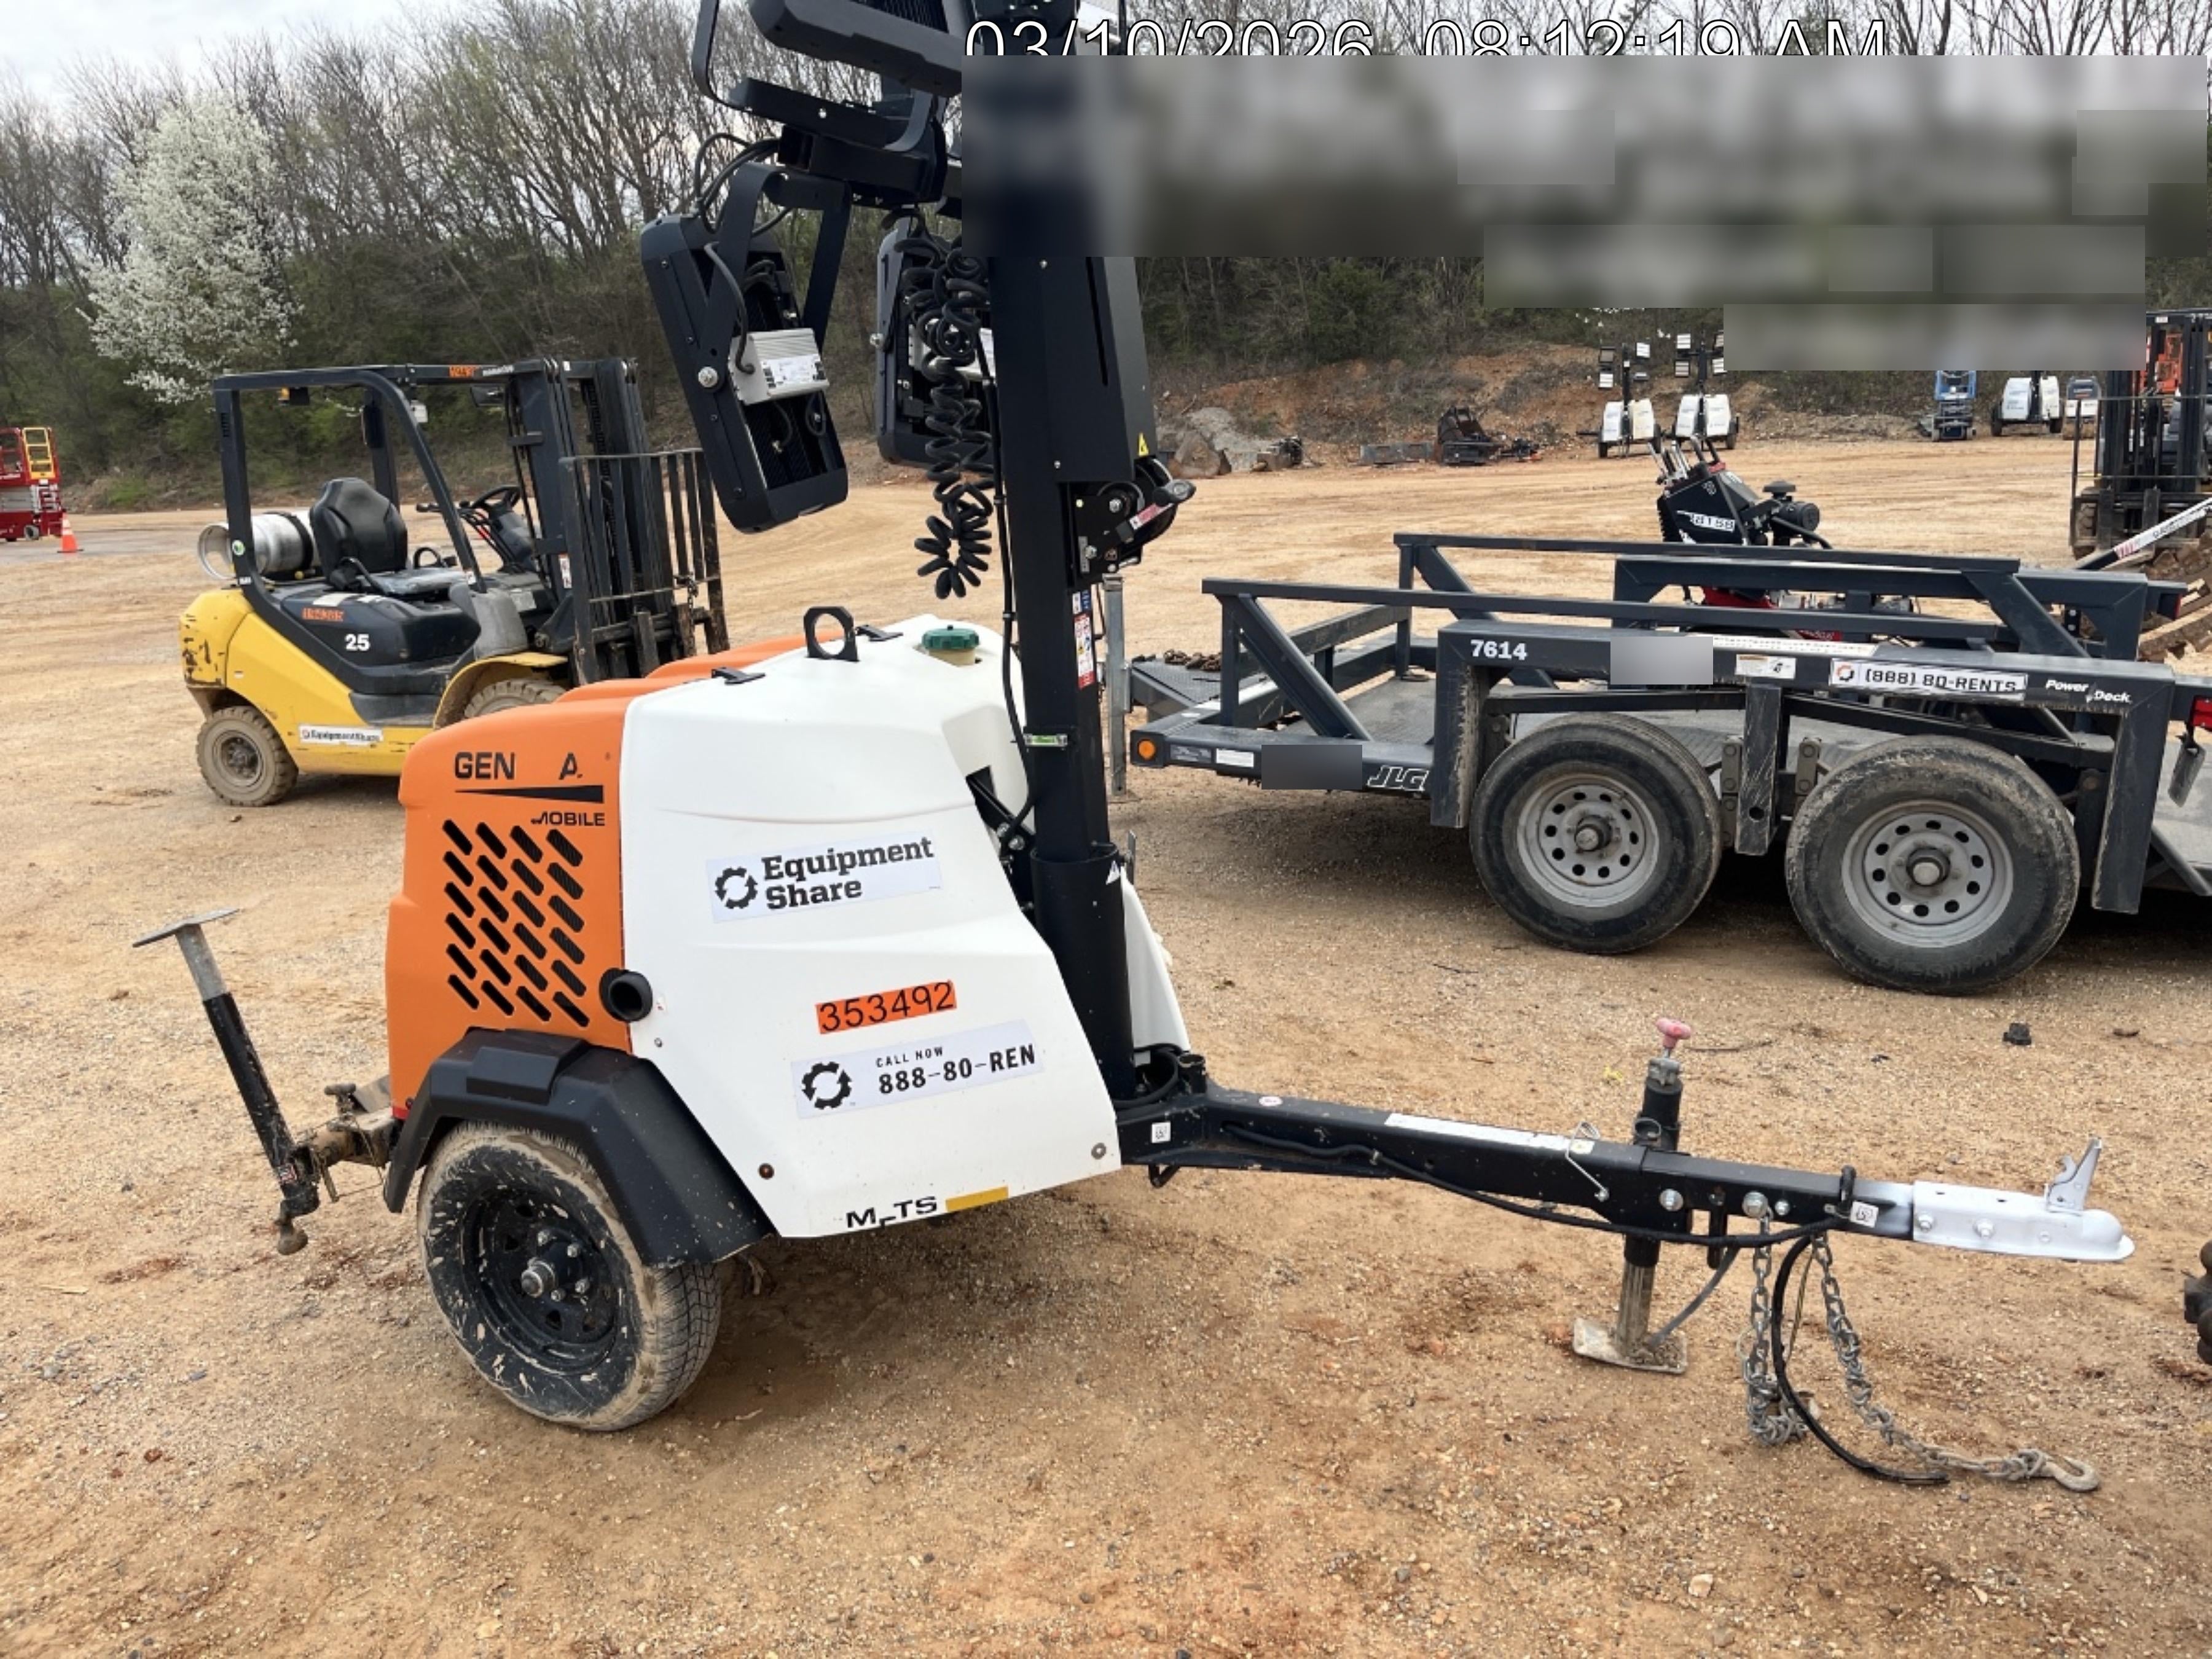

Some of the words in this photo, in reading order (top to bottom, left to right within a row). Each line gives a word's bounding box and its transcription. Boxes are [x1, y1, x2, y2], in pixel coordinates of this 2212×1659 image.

[345, 633, 371, 651] 25
[1470, 639, 1528, 661] 7614
[1865, 669, 1916, 685] (888)
[1923, 674, 2016, 692] 80-RENTS
[2045, 679, 2089, 692] Power
[2095, 689, 2131, 704] Deck
[1367, 764, 1430, 792] JLG
[761, 836, 935, 880] Equipment
[766, 879, 862, 911] Share
[819, 981, 955, 1032] 353492
[876, 1053, 909, 1068] CALL
[916, 1046, 943, 1061] NOW
[879, 1043, 1035, 1094] 888-80-REN
